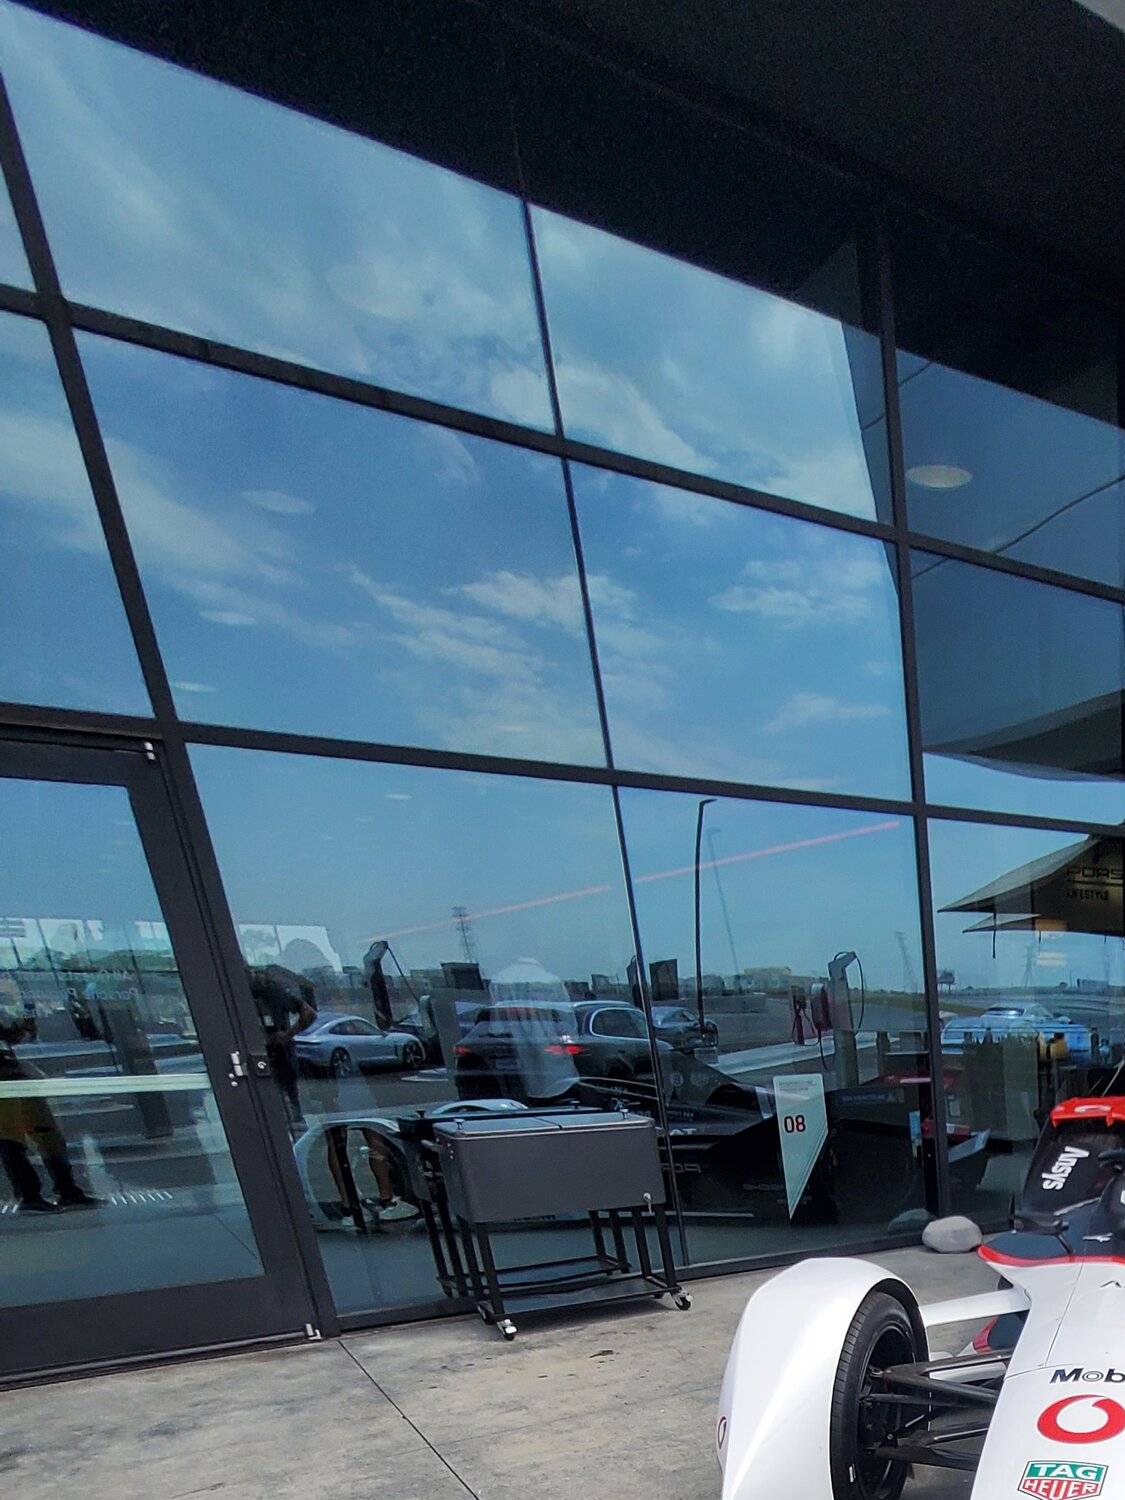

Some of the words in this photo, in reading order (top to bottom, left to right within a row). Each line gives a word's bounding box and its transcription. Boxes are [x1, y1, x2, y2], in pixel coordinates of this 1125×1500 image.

[784, 1115, 806, 1133] 08
[1042, 1146, 1090, 1190] Ansys
[1033, 1464, 1099, 1480] TAG
[1023, 1479, 1097, 1500] HEUER
